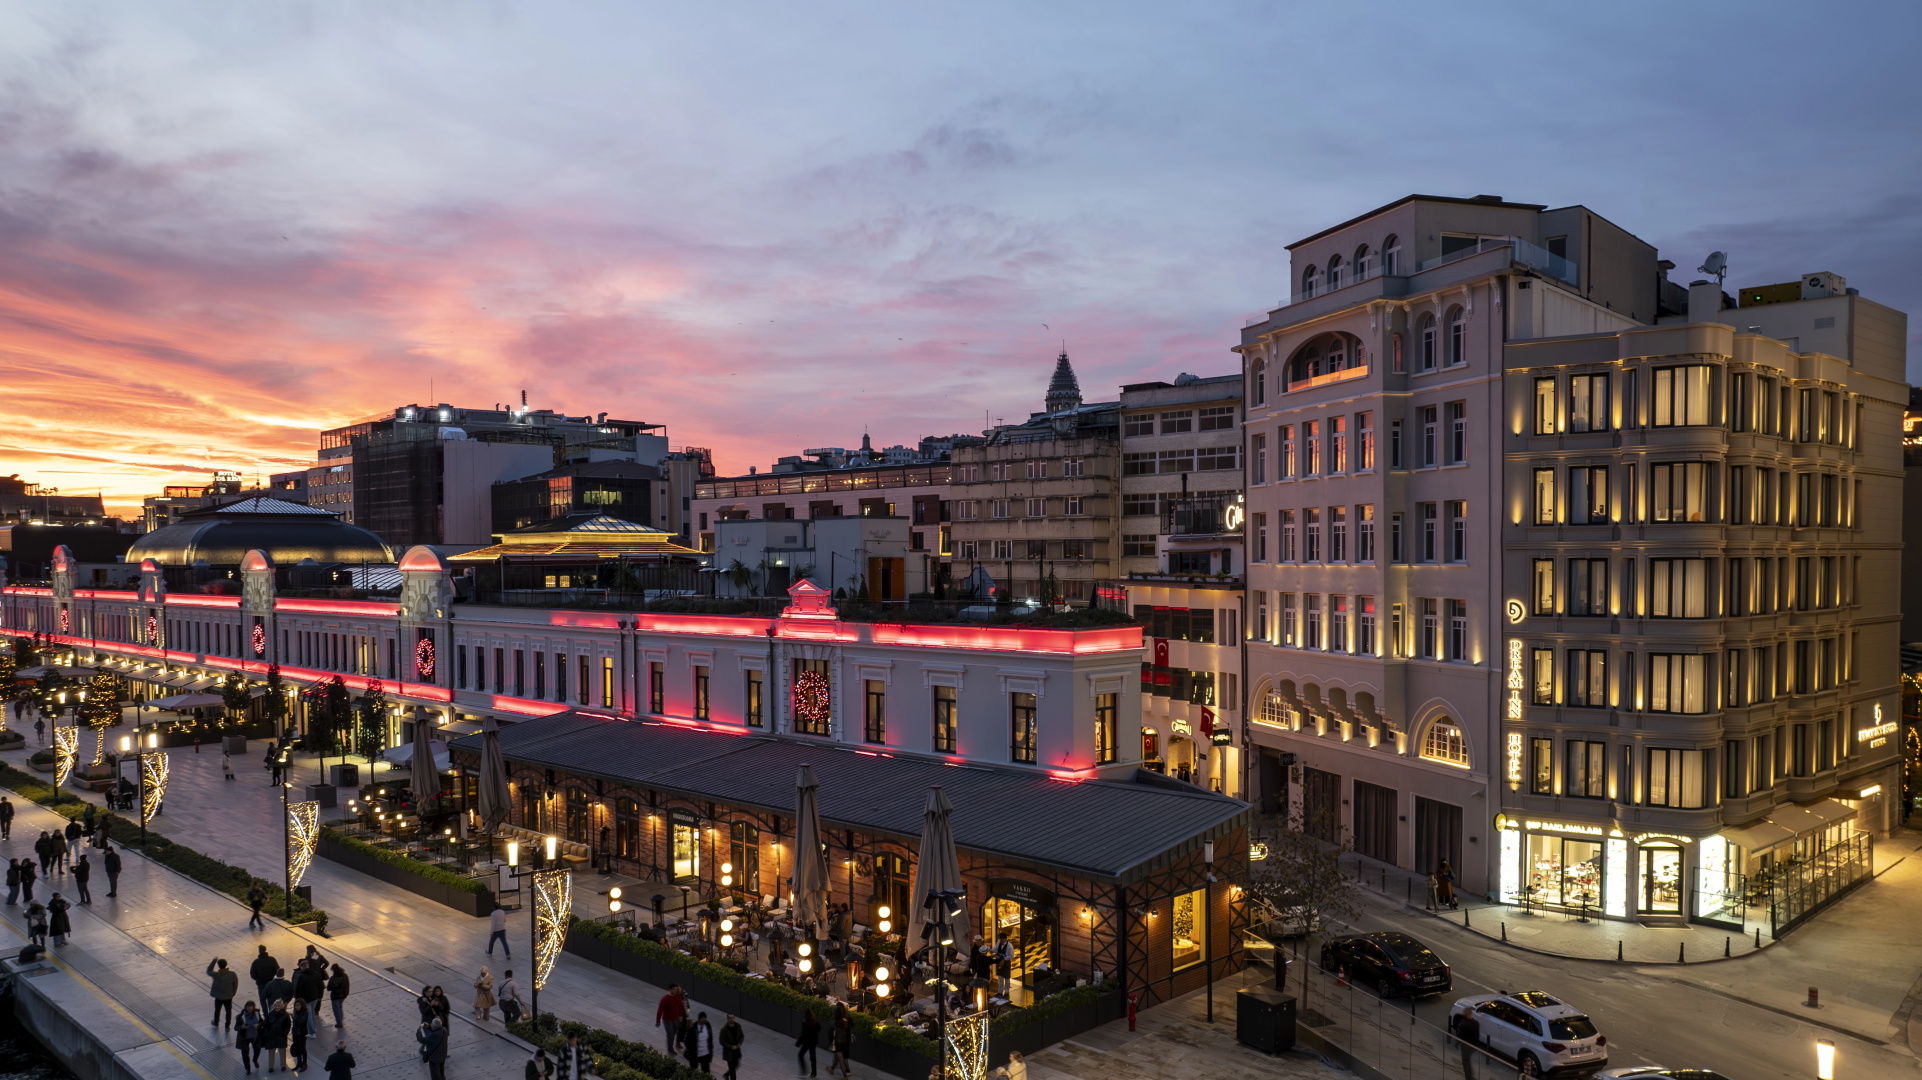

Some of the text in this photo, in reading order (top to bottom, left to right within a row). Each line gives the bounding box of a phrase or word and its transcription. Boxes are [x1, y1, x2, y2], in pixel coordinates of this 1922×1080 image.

[1508, 639, 1523, 689] DREAM
[1508, 690, 1521, 718] INN
[1508, 733, 1521, 779] HOTEL
[1012, 884, 1031, 893] VAKKO
